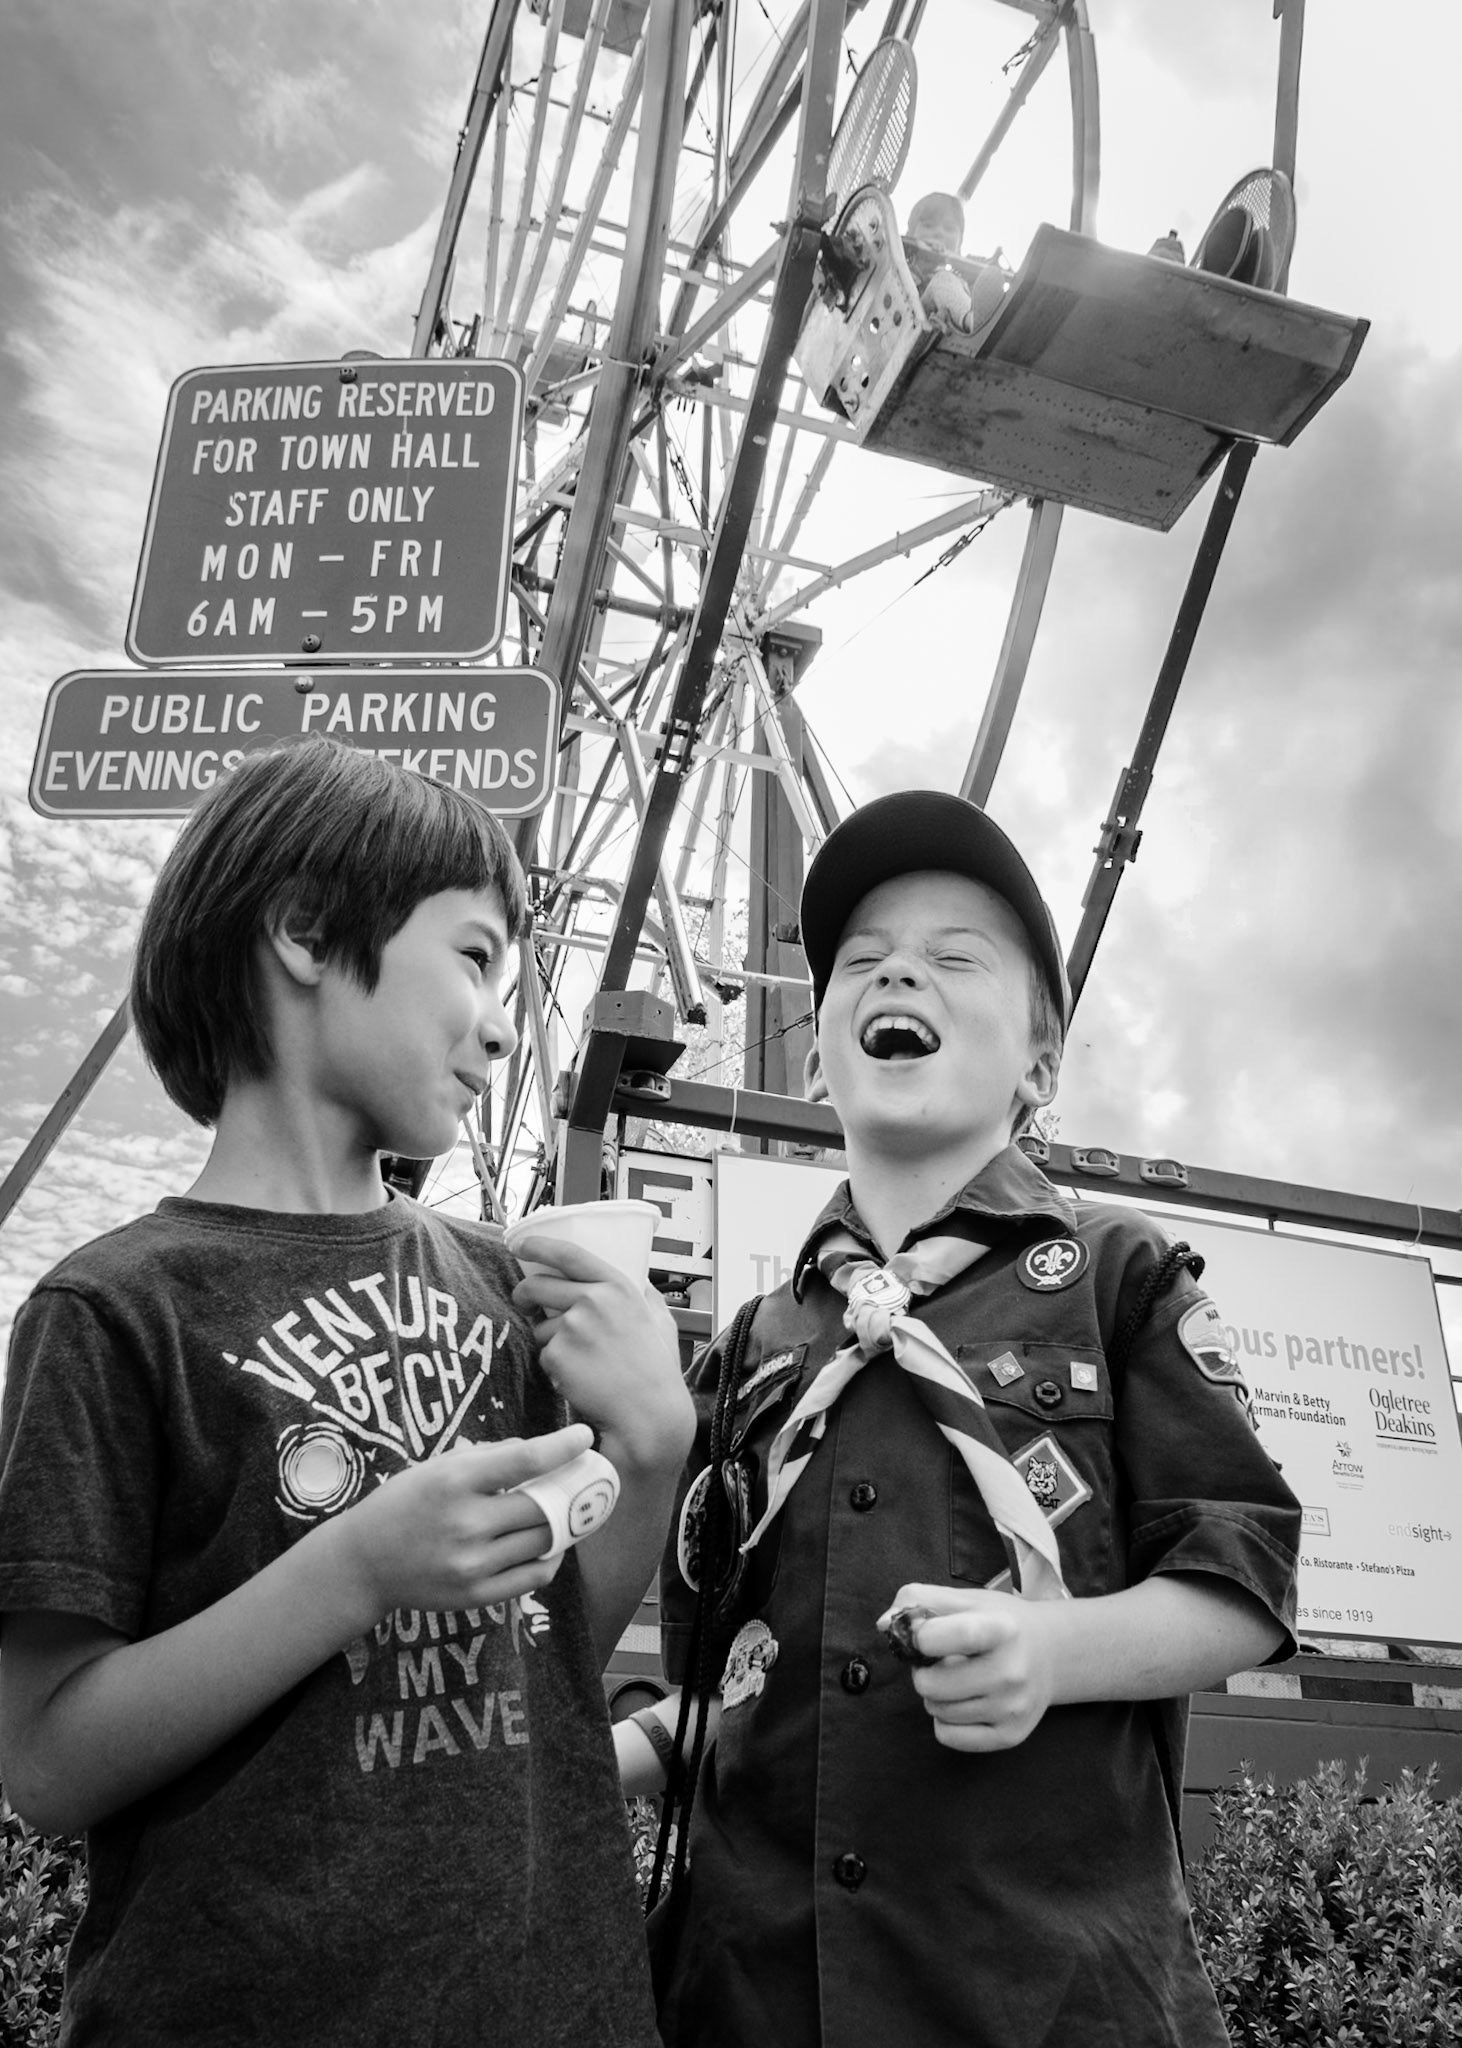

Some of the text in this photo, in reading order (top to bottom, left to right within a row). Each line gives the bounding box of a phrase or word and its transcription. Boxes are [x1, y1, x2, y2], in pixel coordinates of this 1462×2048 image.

[191, 382, 495, 424] PARKING RESERVED
[193, 432, 480, 475] FOR TOWN HALL
[225, 486, 435, 527] STAFF ONLY
[201, 542, 293, 582] MON
[370, 539, 442, 577] FRI
[187, 597, 276, 637] 6AM
[350, 595, 443, 634] 5PM
[100, 692, 496, 734] PUBLIC PARKING
[241, 1271, 493, 1402] VENTURA
[1284, 1334, 1425, 1380] partners!
[1255, 1388, 1331, 1411] Marvin & Betty
[1288, 1407, 1346, 1427] Foundation
[1368, 1387, 1430, 1415] Ogletree
[1374, 1410, 1436, 1438] Deakins
[1388, 1522, 1444, 1543] endsight
[1313, 1557, 1353, 1571] Ristorante
[1361, 1561, 1395, 1575] Stefano's
[1396, 1565, 1415, 1577] Pizza
[1312, 1606, 1342, 1621] since
[1346, 1609, 1374, 1623] 1919
[398, 1634, 487, 1700] MY
[354, 1690, 530, 1772] WAVE
